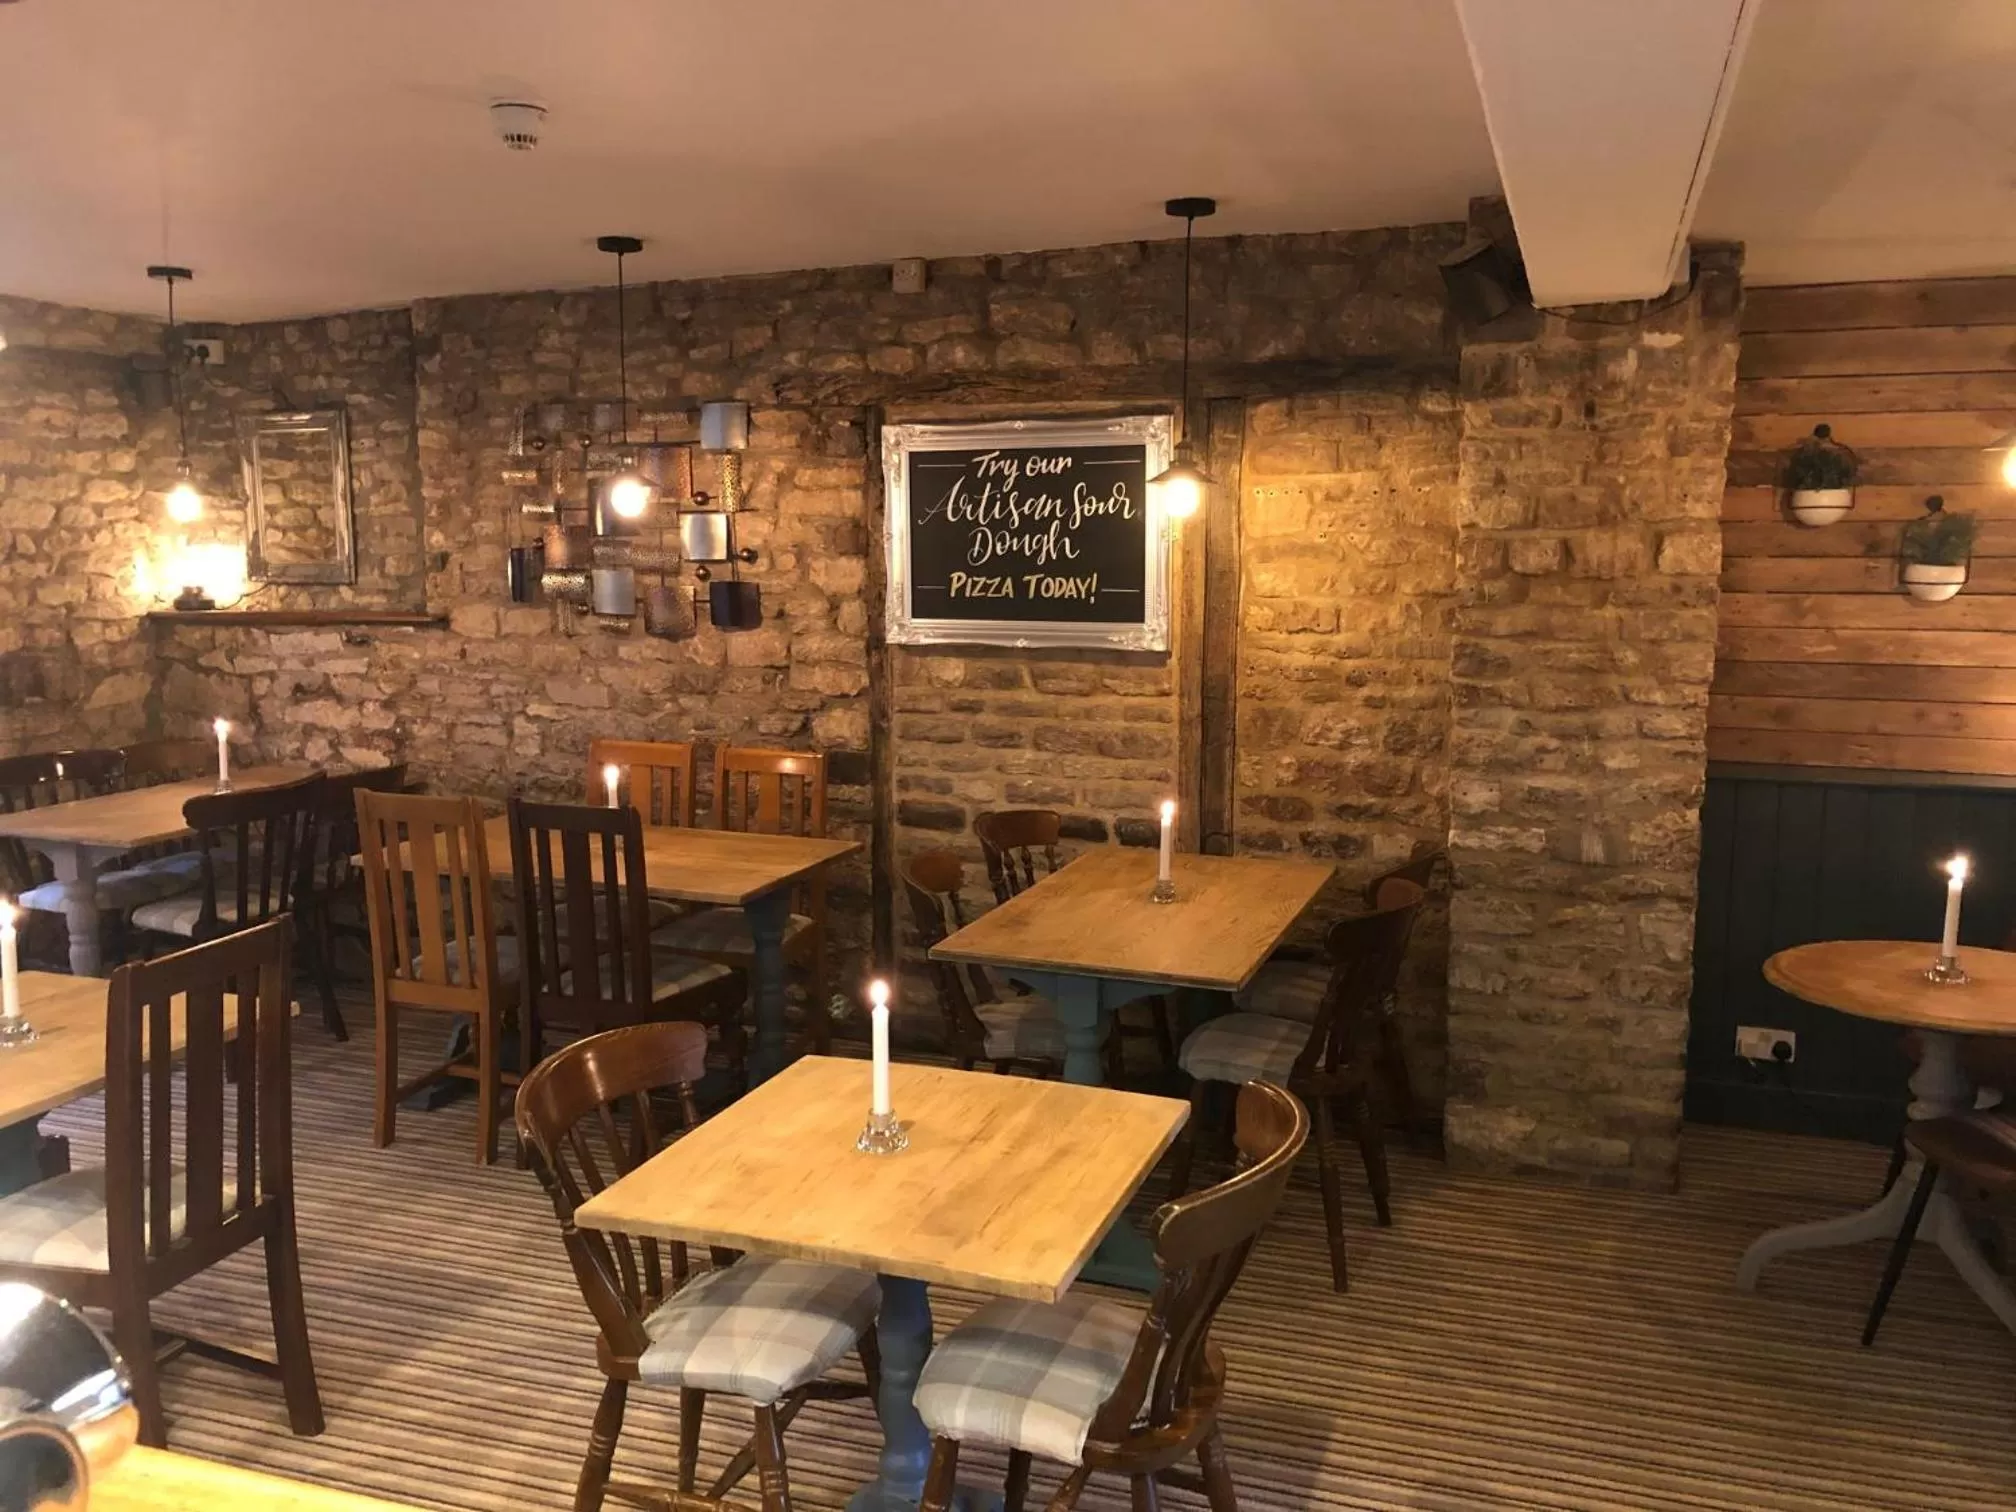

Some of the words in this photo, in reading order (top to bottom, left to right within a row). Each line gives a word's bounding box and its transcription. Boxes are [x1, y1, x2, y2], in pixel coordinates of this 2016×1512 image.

[972, 451, 1020, 491] Try
[1025, 455, 1072, 477] our
[918, 476, 1067, 528] Artisan
[1069, 482, 1135, 530] Sour
[967, 520, 1080, 566] Dough
[950, 572, 1014, 598] PIZZA
[1022, 573, 1098, 604] TODAY!
